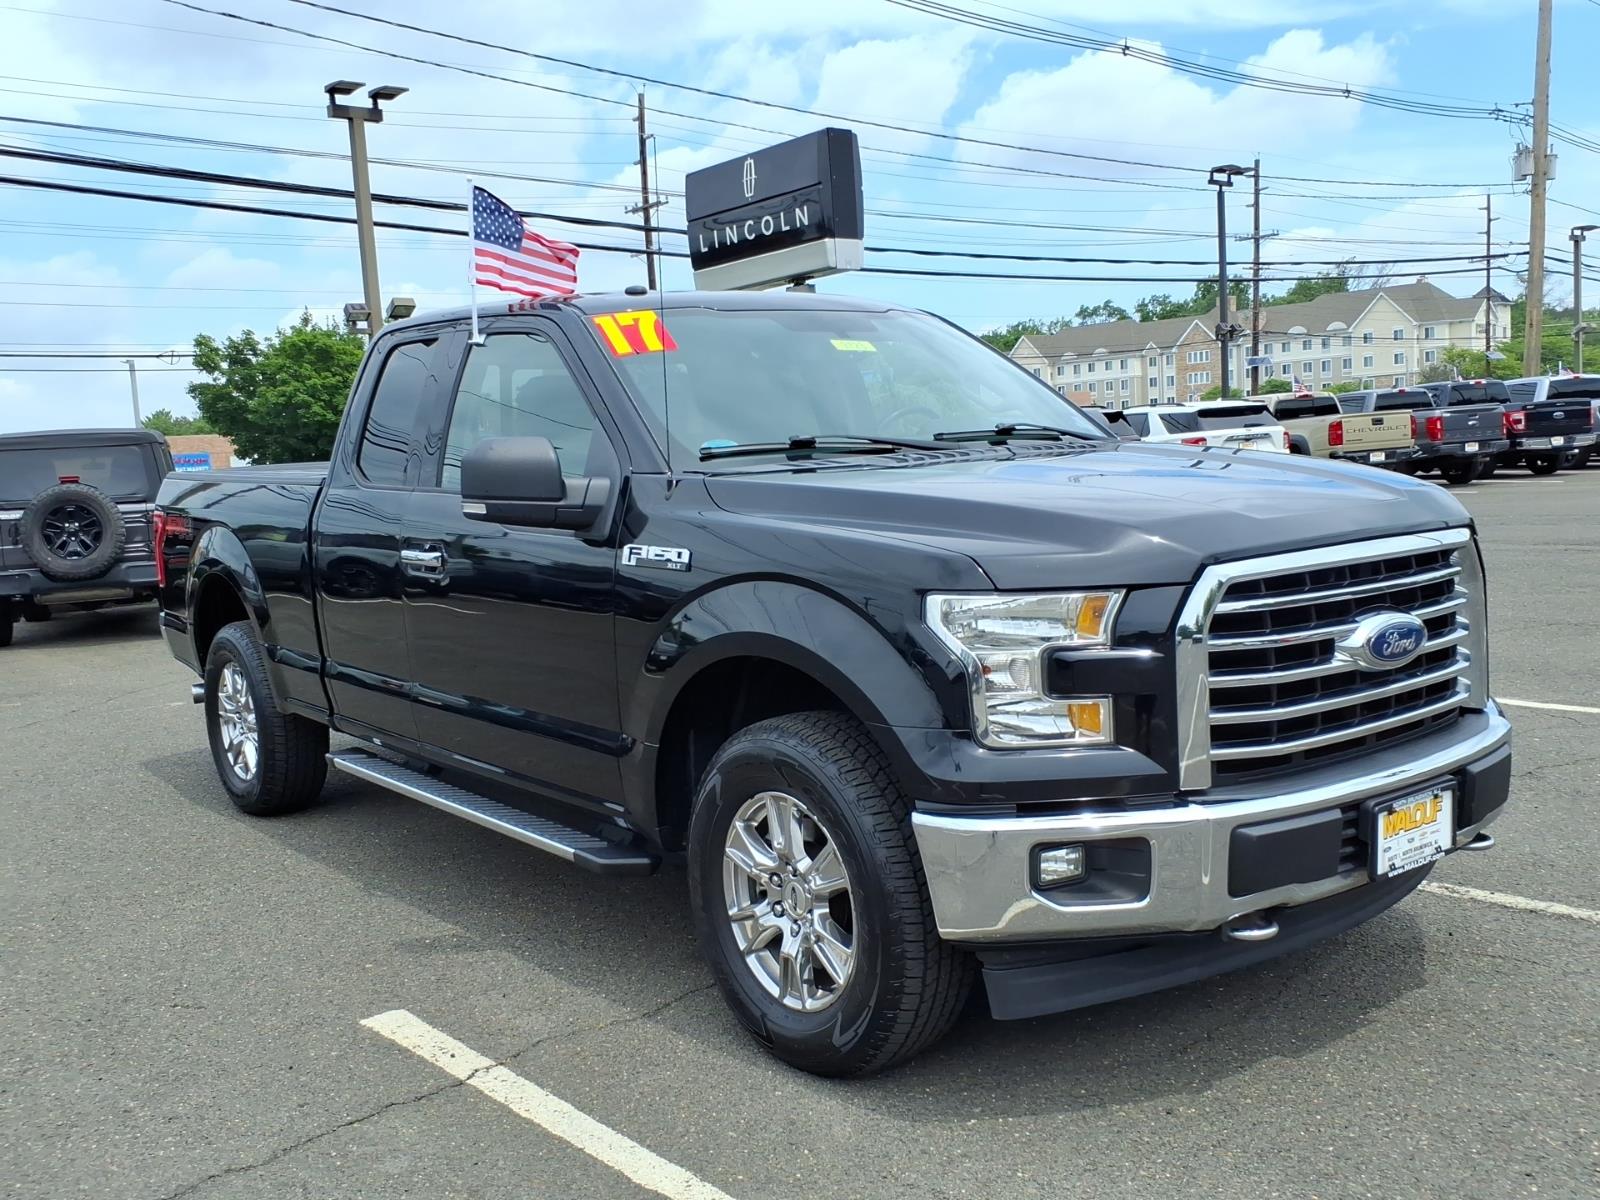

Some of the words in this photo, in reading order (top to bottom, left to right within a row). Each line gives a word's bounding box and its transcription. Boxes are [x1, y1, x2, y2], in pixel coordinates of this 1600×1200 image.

[699, 205, 809, 253] LINCOLN
[593, 310, 664, 354] 17
[1346, 424, 1409, 434] CHEVROLET
[1382, 627, 1417, 656] Ford
[1383, 795, 1444, 840] MALOUF
[1387, 851, 1446, 878] www.MALOUF.com
